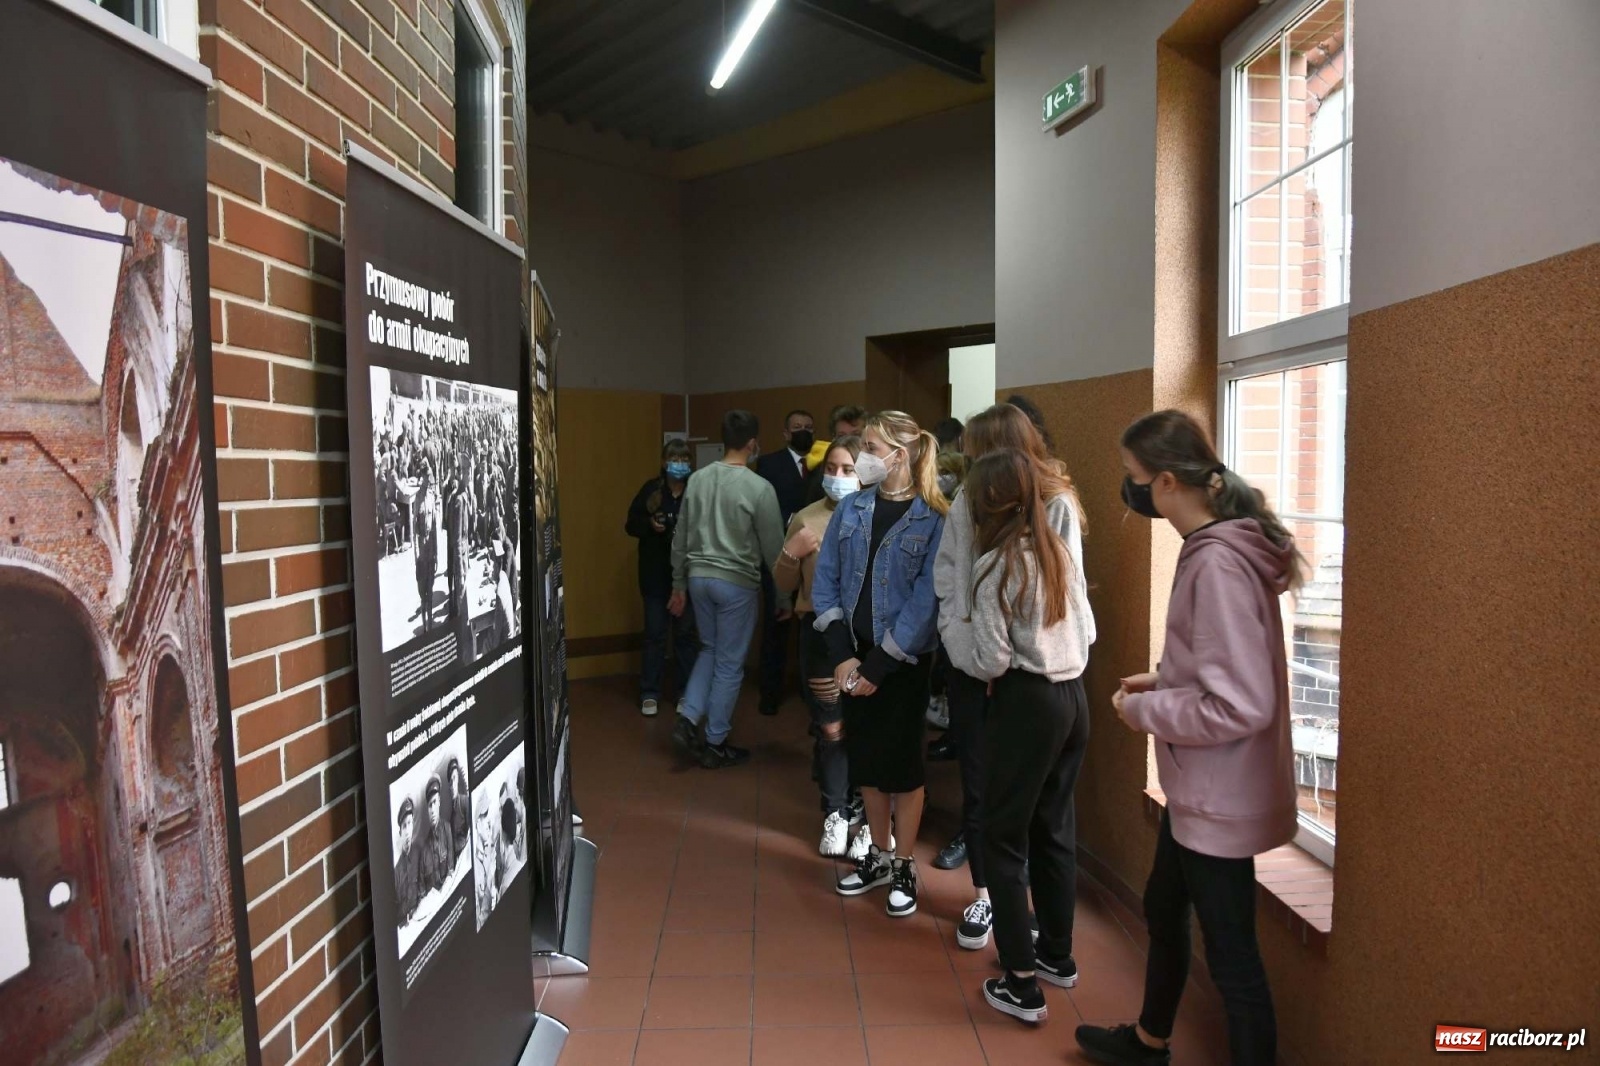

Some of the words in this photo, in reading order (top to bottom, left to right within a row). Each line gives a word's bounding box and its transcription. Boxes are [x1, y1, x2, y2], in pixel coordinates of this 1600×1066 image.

[365, 262, 429, 318] Przymusowy
[431, 290, 455, 323] pobór
[368, 309, 385, 345] do
[386, 318, 412, 351] armii
[413, 323, 470, 366] okupacyjnych
